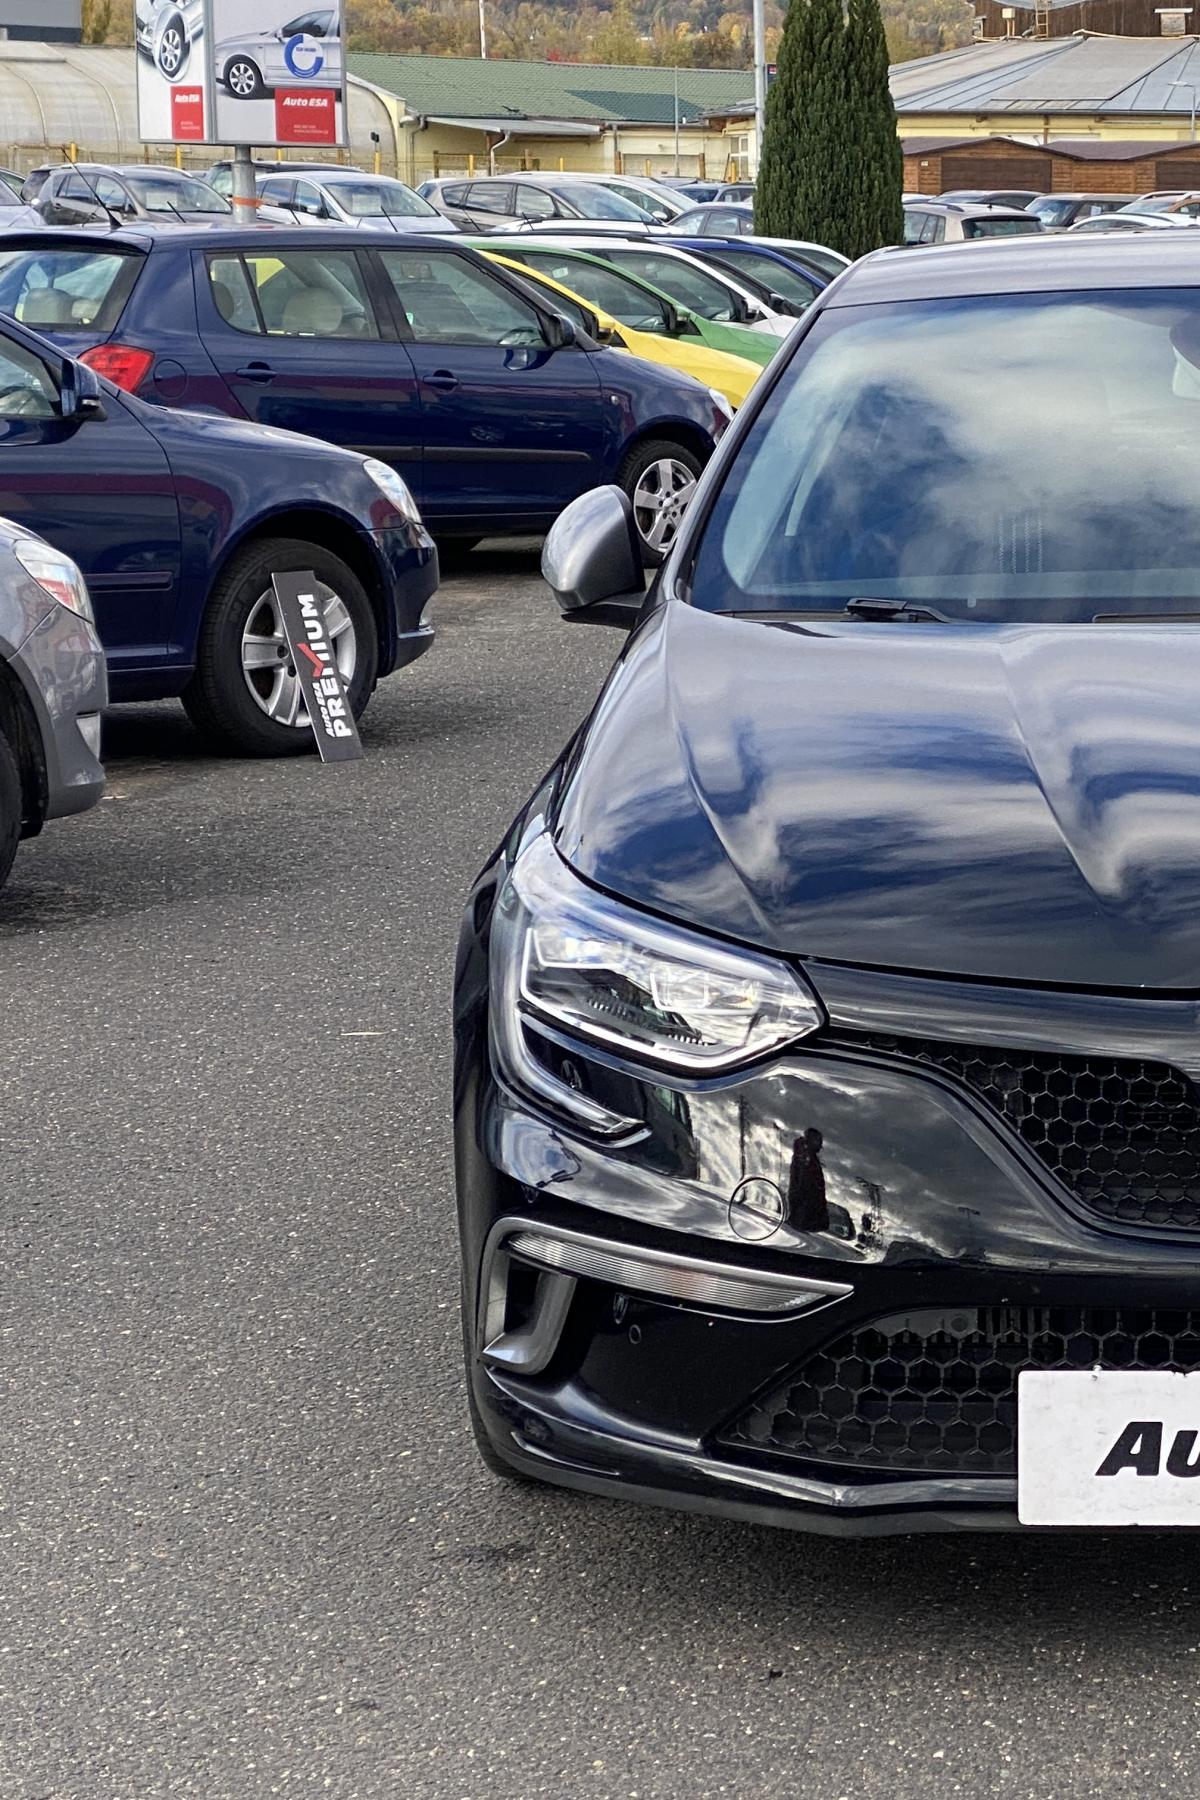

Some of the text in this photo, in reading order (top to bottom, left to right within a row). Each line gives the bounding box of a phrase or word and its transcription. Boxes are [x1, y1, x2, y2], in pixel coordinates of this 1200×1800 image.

[283, 97, 328, 107] Auto ESA
[297, 594, 353, 737] PREMIUM
[312, 682, 326, 706] ESA
